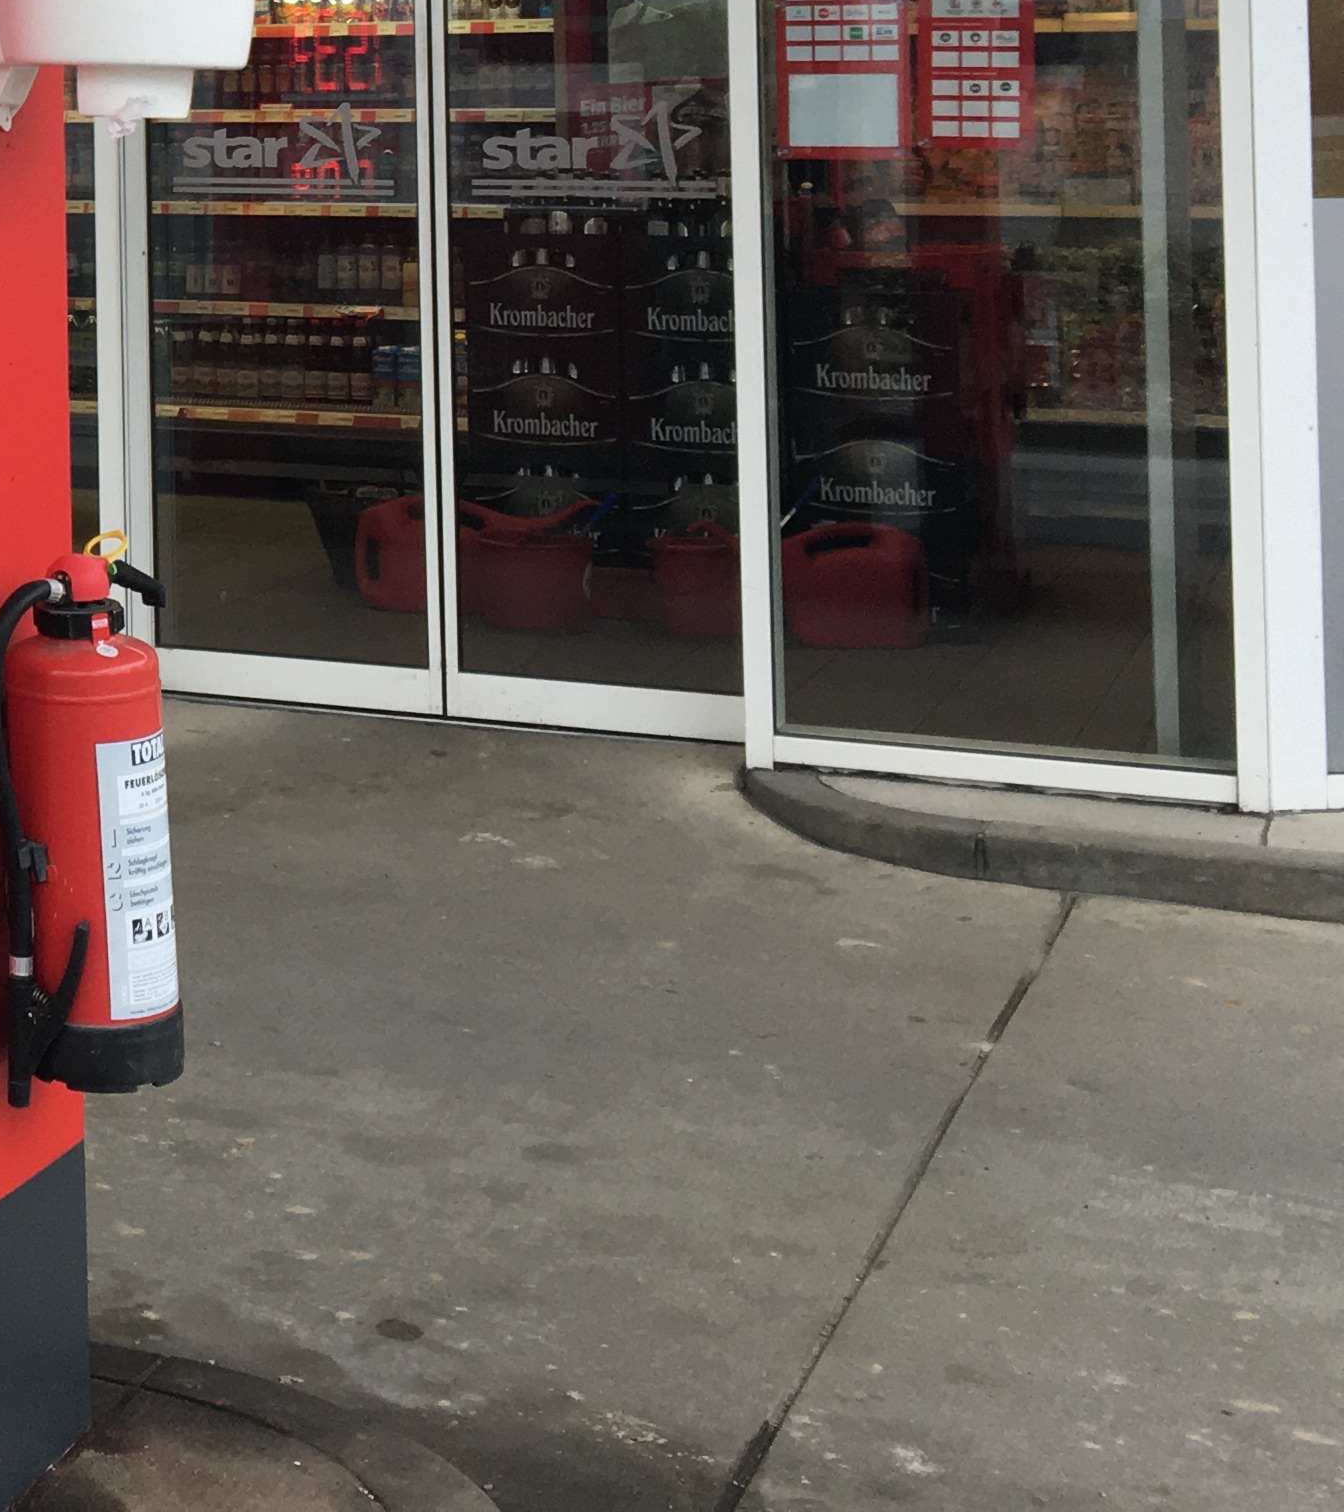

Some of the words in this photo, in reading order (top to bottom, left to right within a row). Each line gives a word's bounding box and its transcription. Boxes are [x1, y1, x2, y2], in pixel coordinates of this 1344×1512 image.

[182, 126, 288, 168] star
[482, 126, 599, 169] star
[489, 302, 595, 329] Krombacher
[816, 363, 932, 392] Krombacher
[493, 409, 598, 438] Krombacher
[820, 476, 936, 507] Krombacher
[144, 917, 152, 929] A
